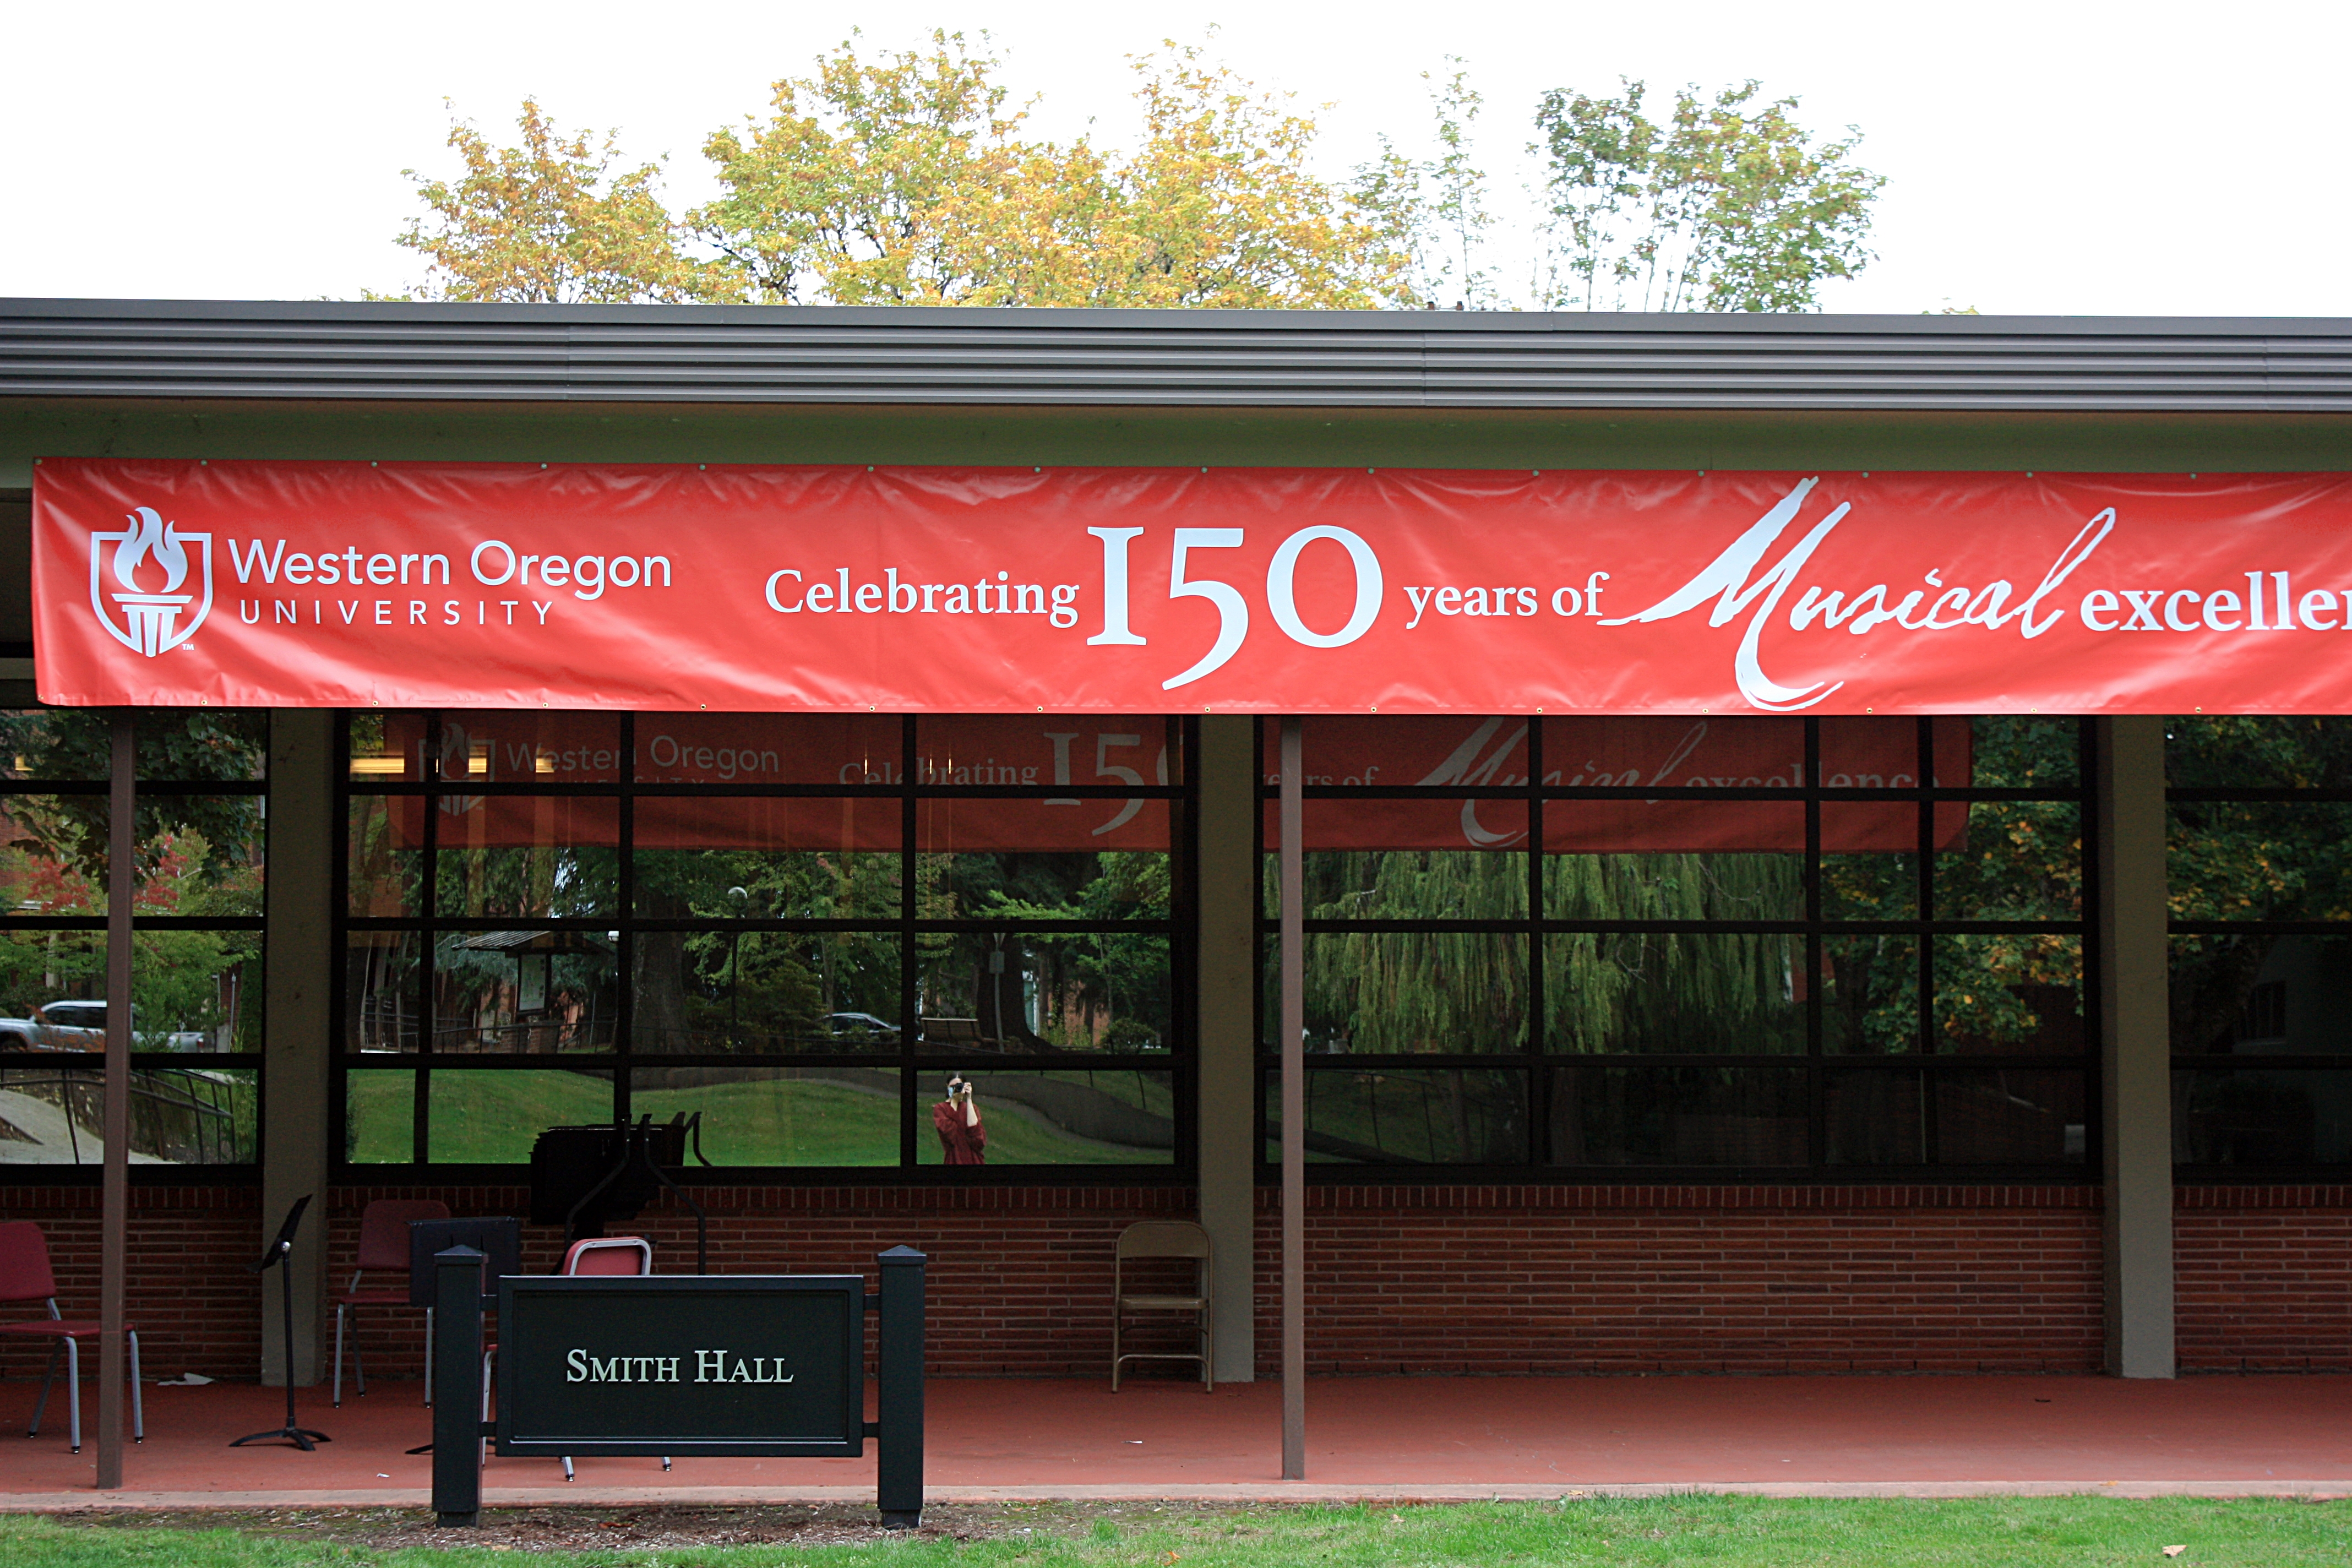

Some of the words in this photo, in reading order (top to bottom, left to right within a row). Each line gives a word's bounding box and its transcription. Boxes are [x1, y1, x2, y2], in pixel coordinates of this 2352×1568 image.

[228, 539, 450, 585] Western
[471, 540, 671, 601] Oregon
[765, 567, 1080, 628] Celebrating
[1086, 525, 1383, 690] 150
[1403, 586, 1538, 629] years
[1551, 571, 1610, 617] of
[1597, 476, 2116, 712] Musical
[2080, 570, 2352, 632] excelle
[241, 600, 553, 625] UNIVERSITY
[650, 734, 779, 780] Oregon
